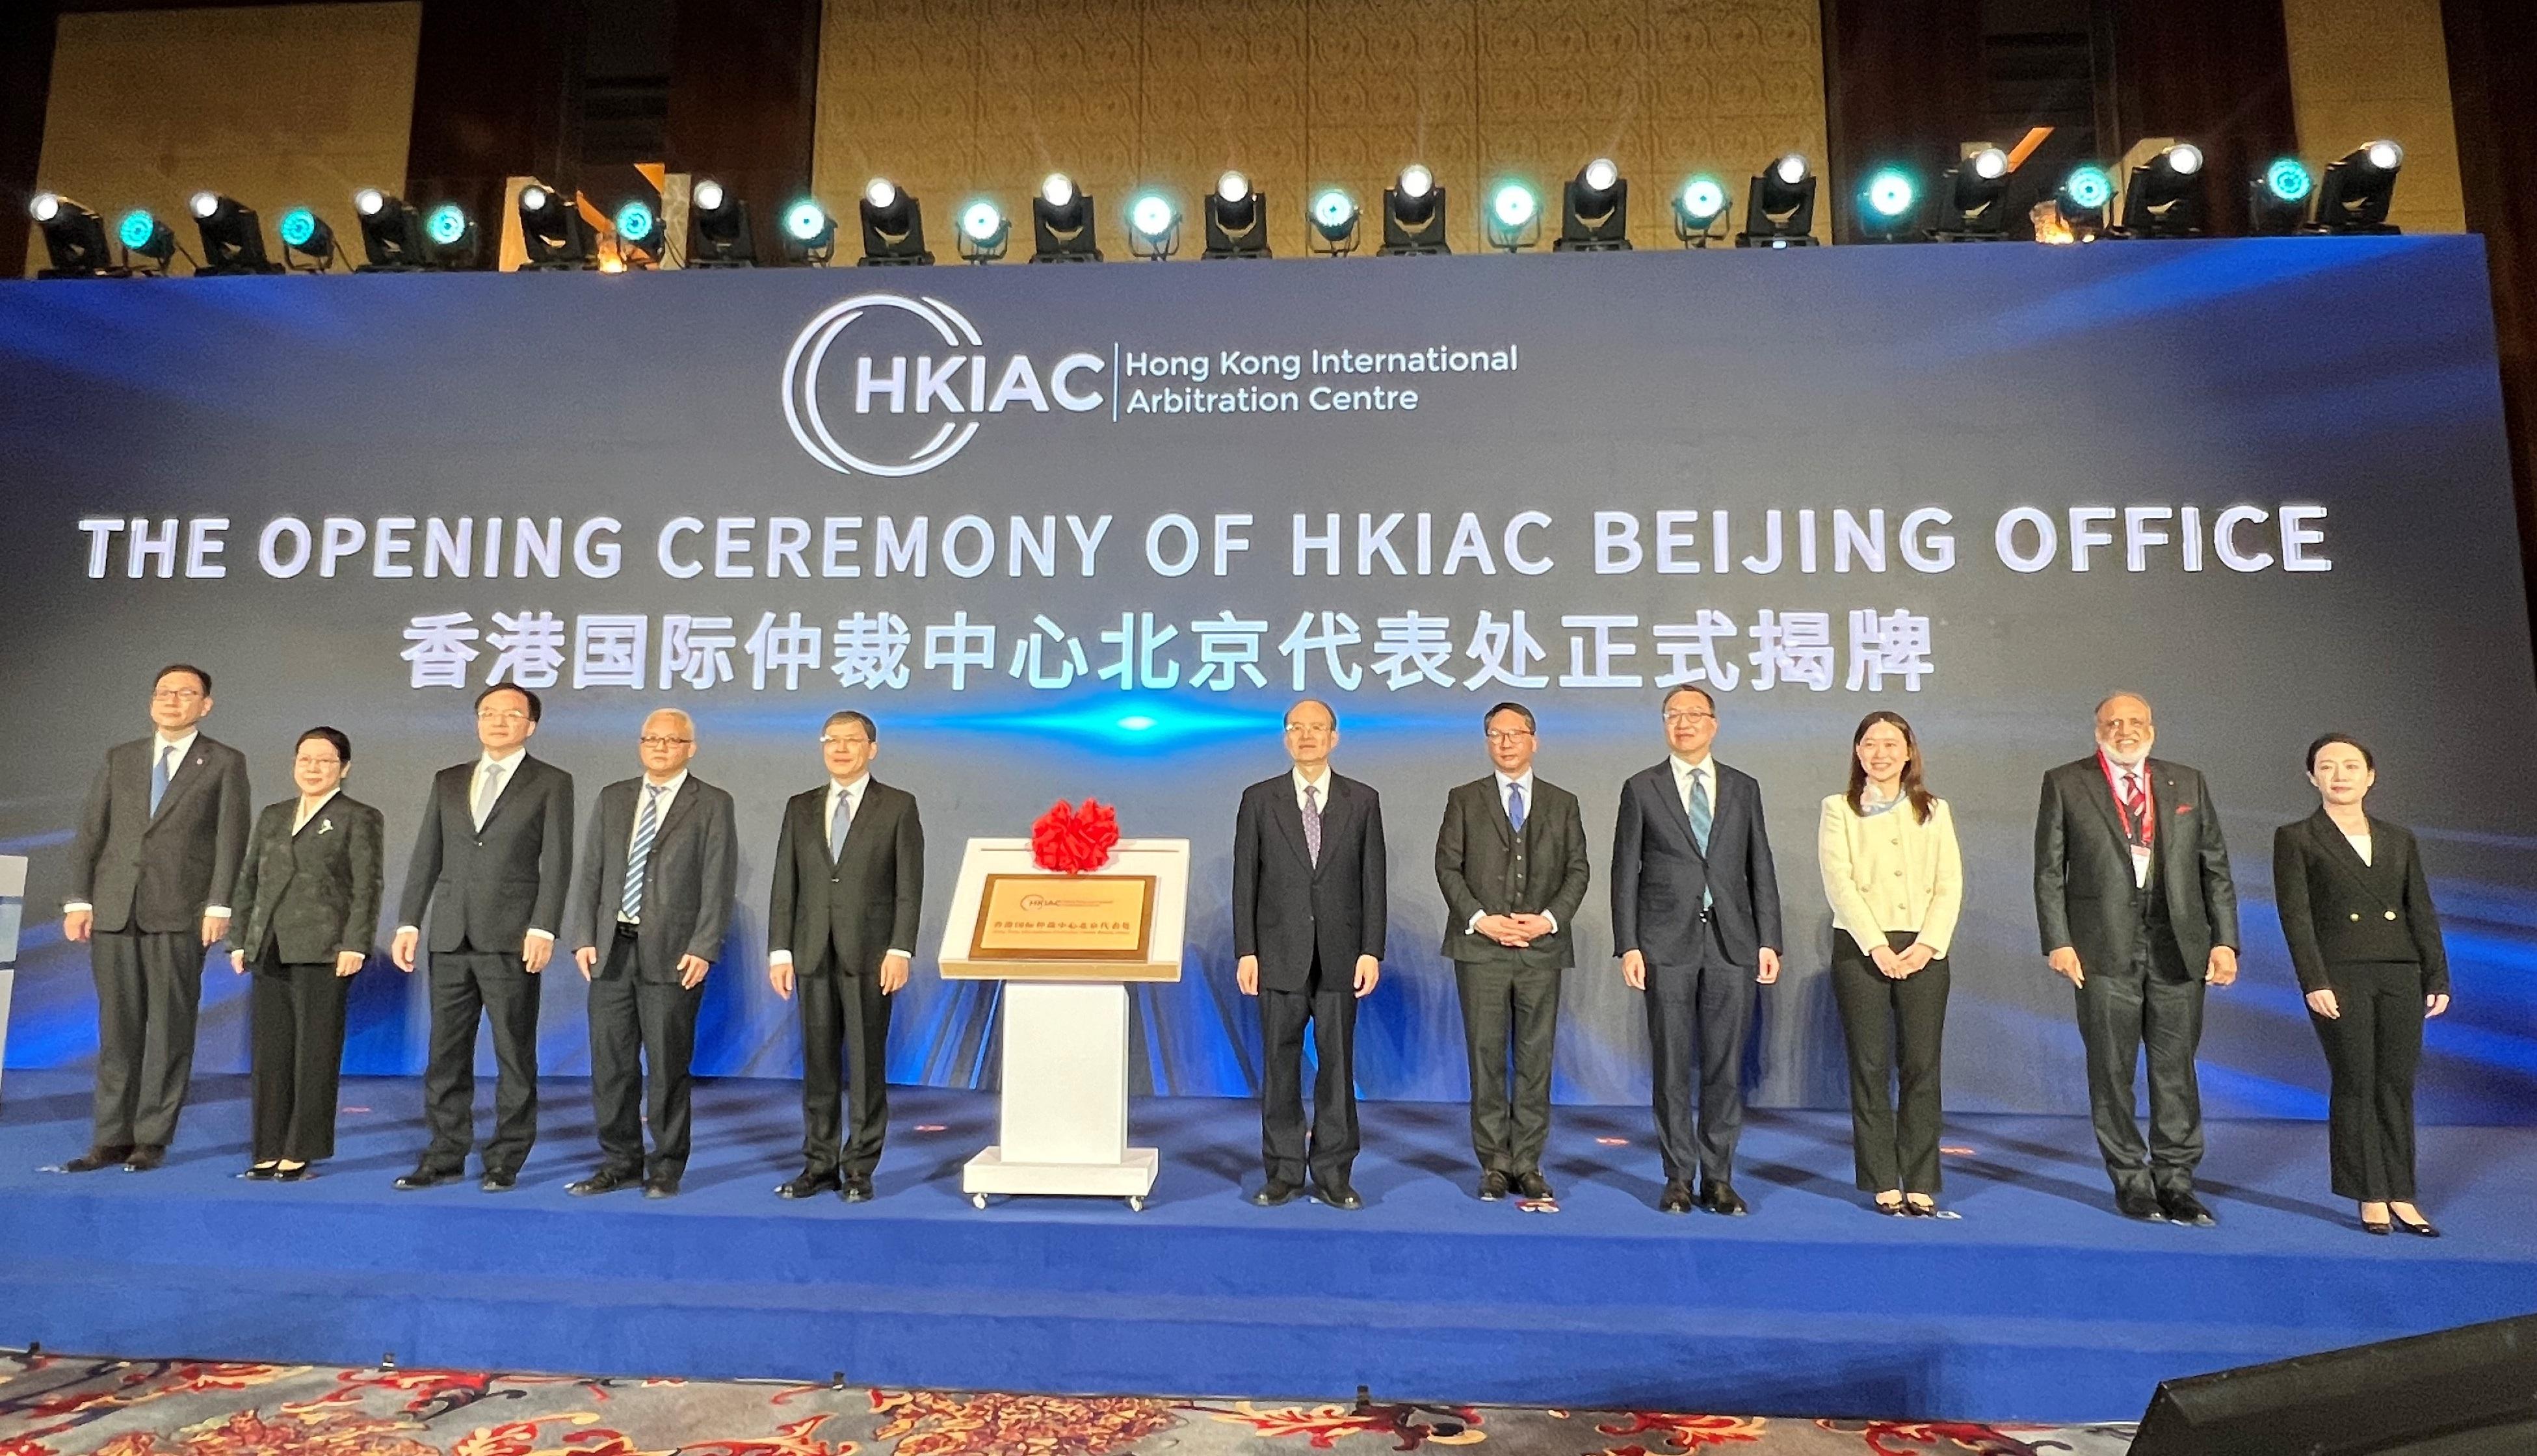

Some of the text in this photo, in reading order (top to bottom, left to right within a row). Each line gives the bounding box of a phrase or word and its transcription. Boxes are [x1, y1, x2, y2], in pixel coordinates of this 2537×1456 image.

[854, 353, 1106, 415] HKIAC
[1125, 344, 1519, 384] Hong Kong International
[1126, 385, 1420, 415] Arbitration Centre
[79, 505, 2333, 580] THE OPENING CEREMONY OF HKIAC BEIJING OFFICE
[399, 608, 1935, 693] 香港国际仲裁中心北京代表处正式揭牌
